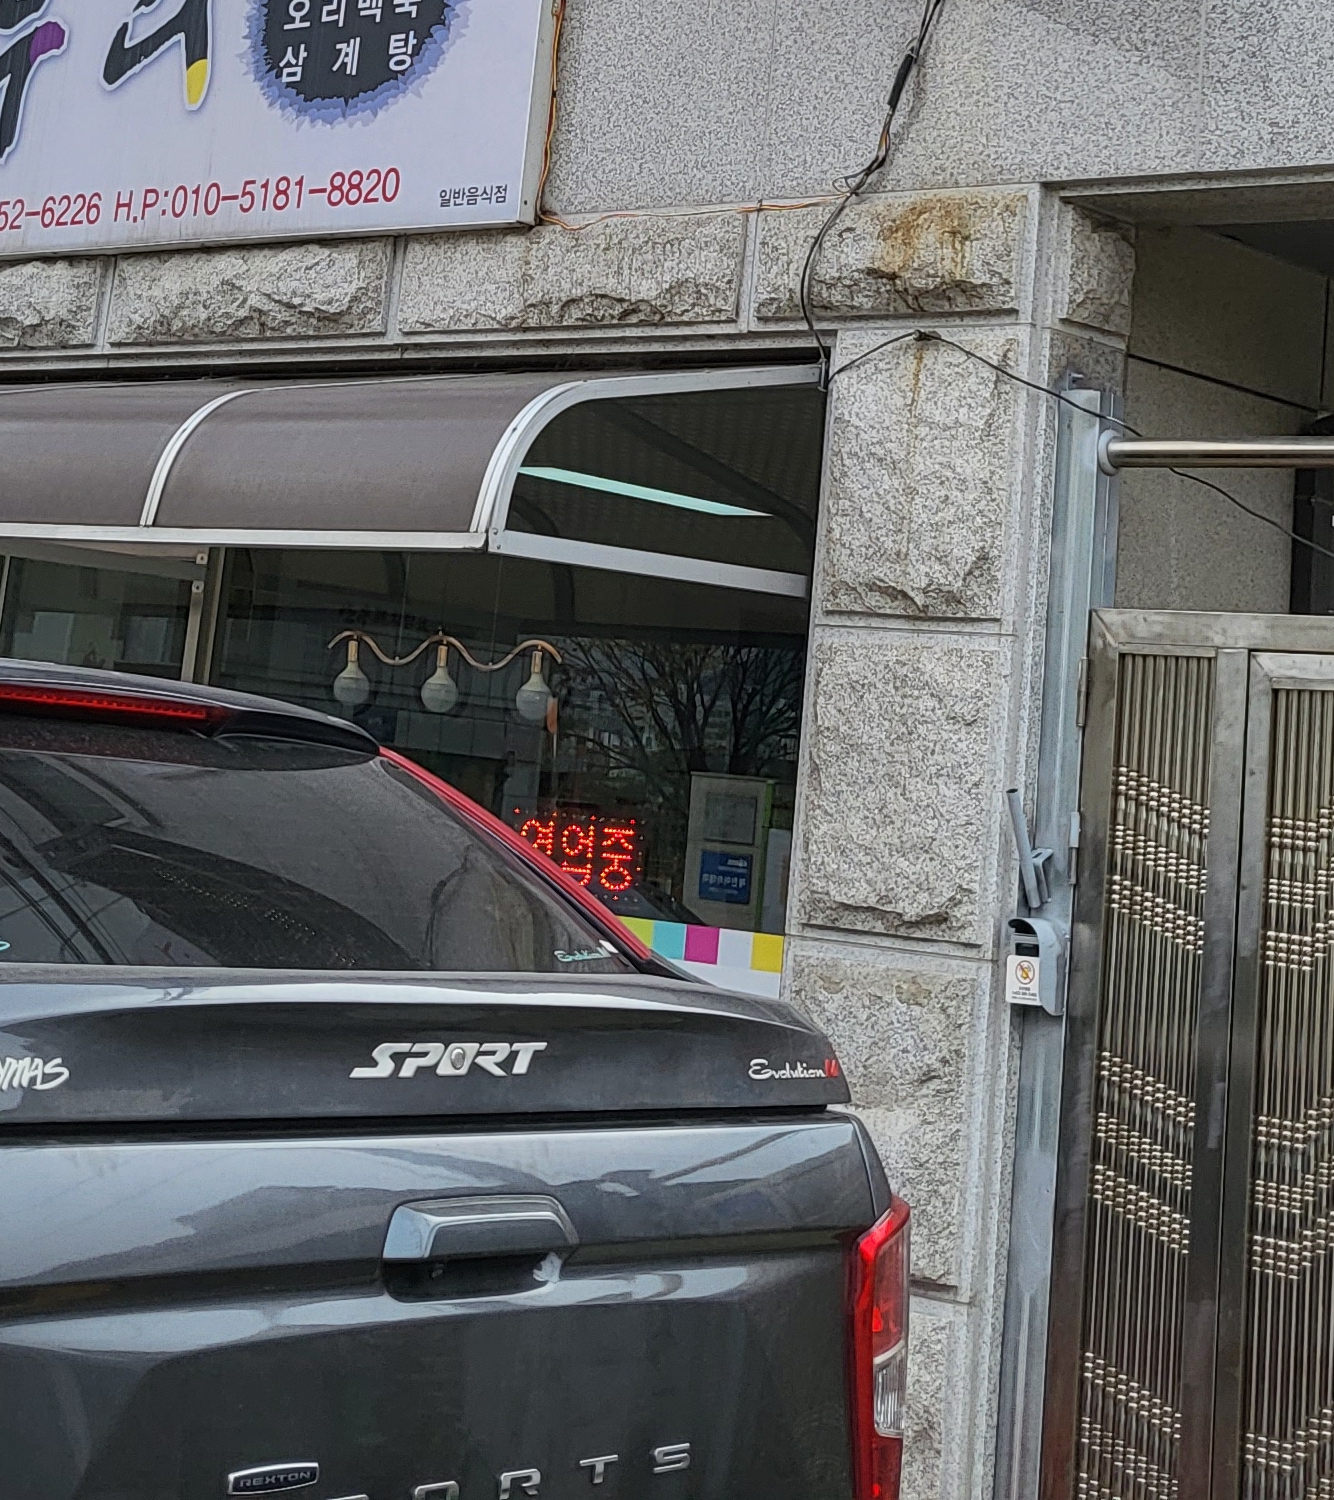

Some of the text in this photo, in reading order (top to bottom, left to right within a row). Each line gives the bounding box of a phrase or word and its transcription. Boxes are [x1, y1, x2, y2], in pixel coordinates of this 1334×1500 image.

[279, 30, 417, 83] 삼계탕
[112, 167, 400, 225] H.P:010-5181-8820
[439, 183, 508, 208] 일반음식점
[349, 1042, 548, 1079] SPORT
[748, 1057, 826, 1081] Evolution
[239, 1471, 311, 1488] REXTON
